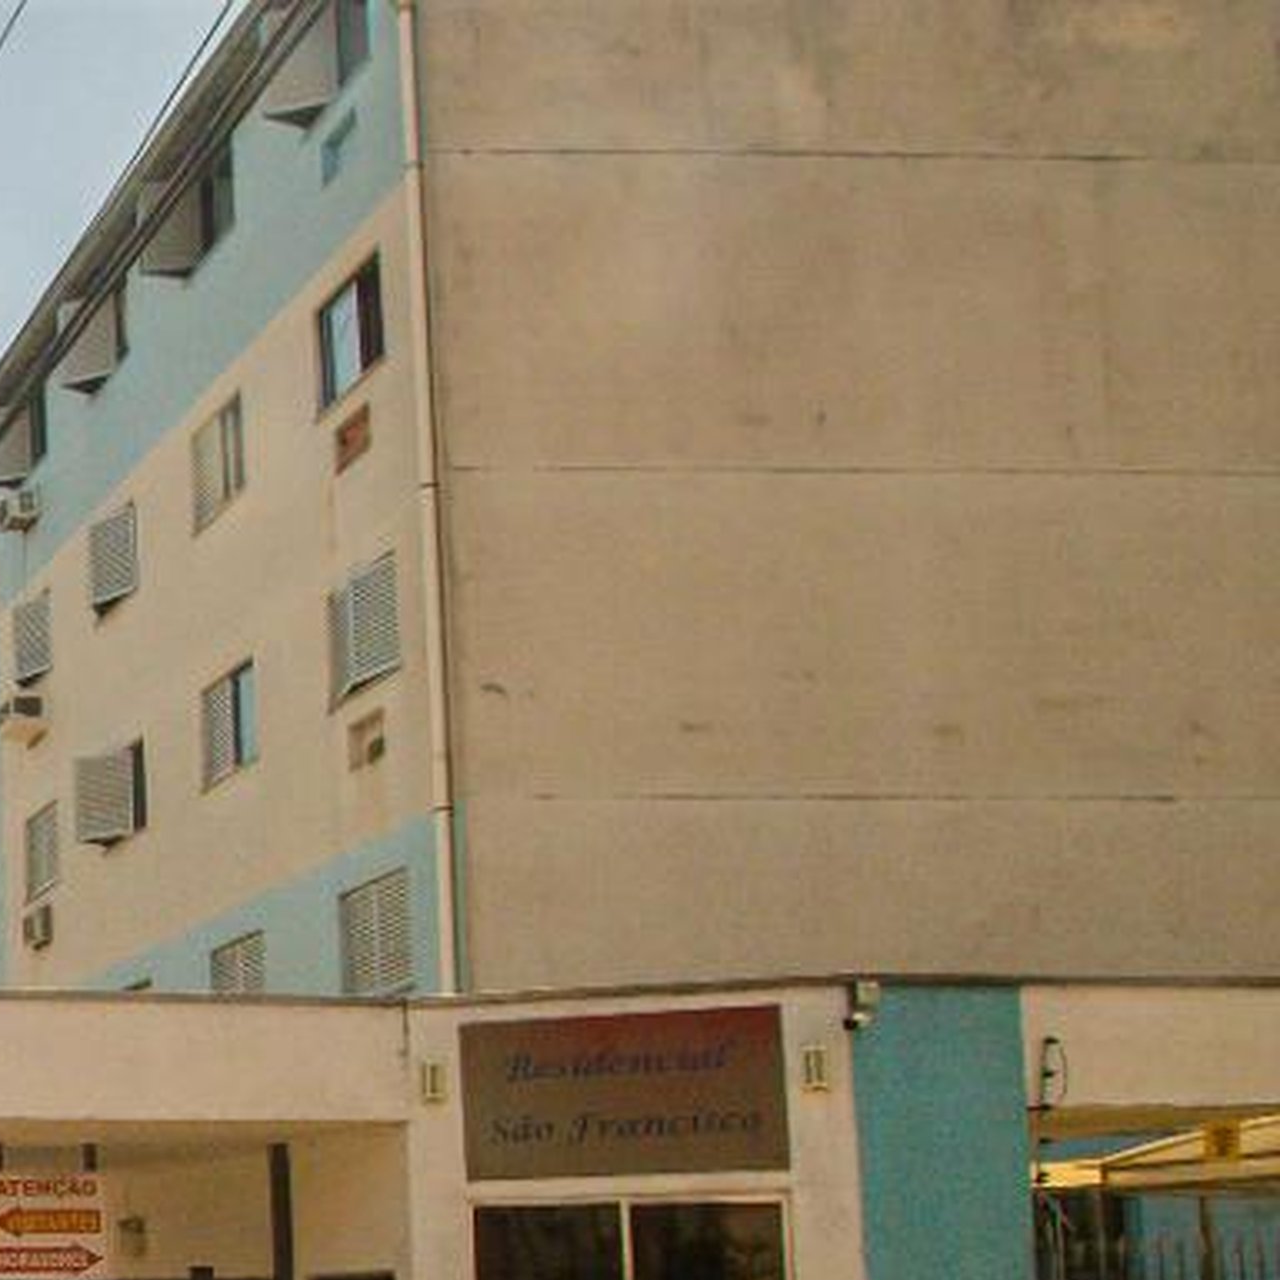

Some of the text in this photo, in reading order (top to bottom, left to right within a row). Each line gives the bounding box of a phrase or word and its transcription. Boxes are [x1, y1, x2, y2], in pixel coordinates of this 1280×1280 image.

[505, 1039, 736, 1082] Residencial
[490, 1106, 762, 1146] São Francisco
